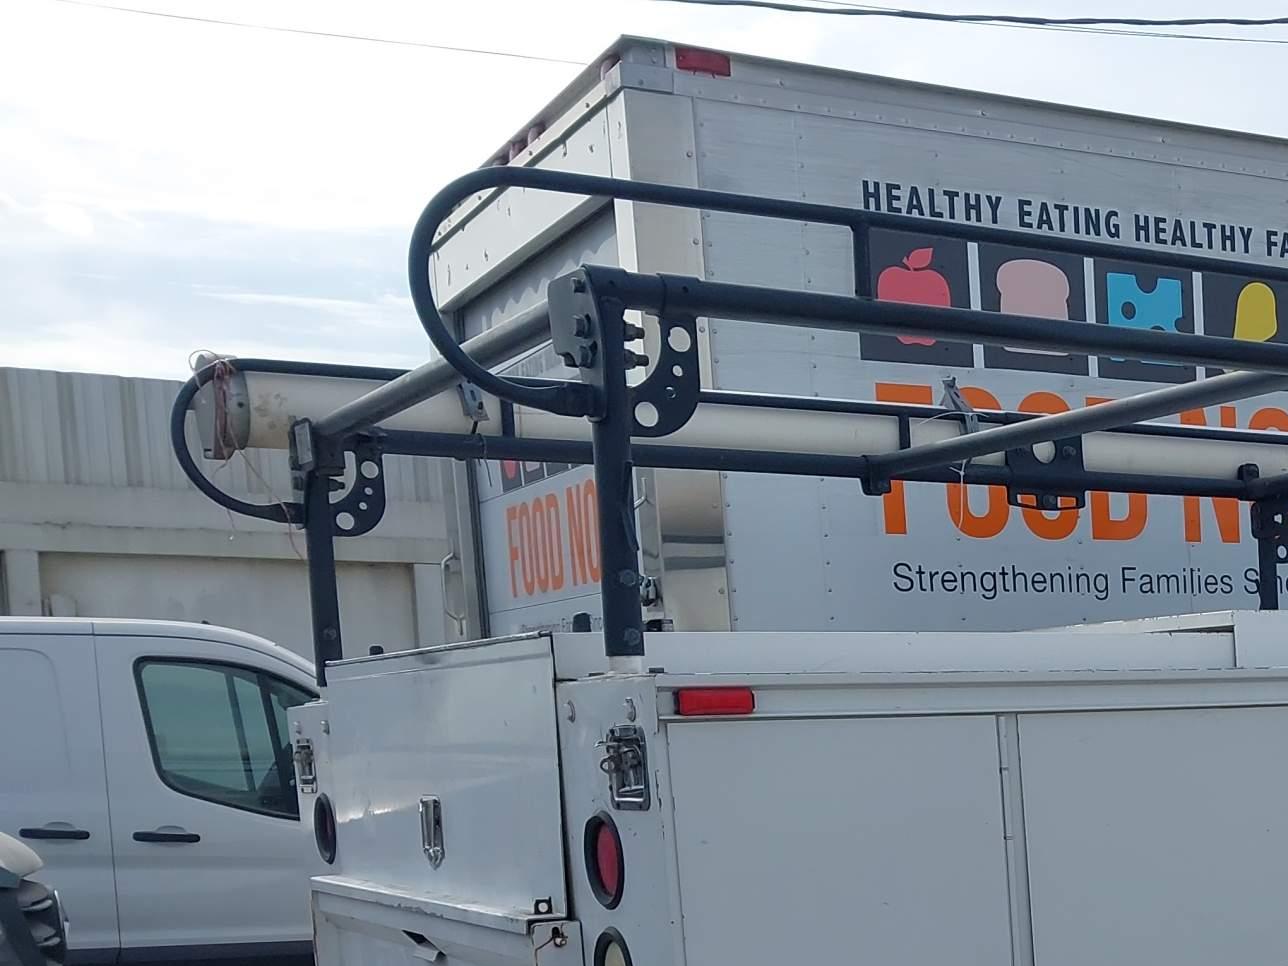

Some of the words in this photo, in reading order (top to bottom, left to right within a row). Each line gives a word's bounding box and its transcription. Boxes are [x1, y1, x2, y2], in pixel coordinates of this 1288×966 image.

[862, 179, 1002, 225] HEALTHY
[1018, 199, 1121, 240] EATING
[1134, 213, 1253, 254] HEALTHY
[506, 492, 564, 598] FOOD
[893, 562, 1109, 600] Strengthening
[1121, 566, 1234, 595] Families
